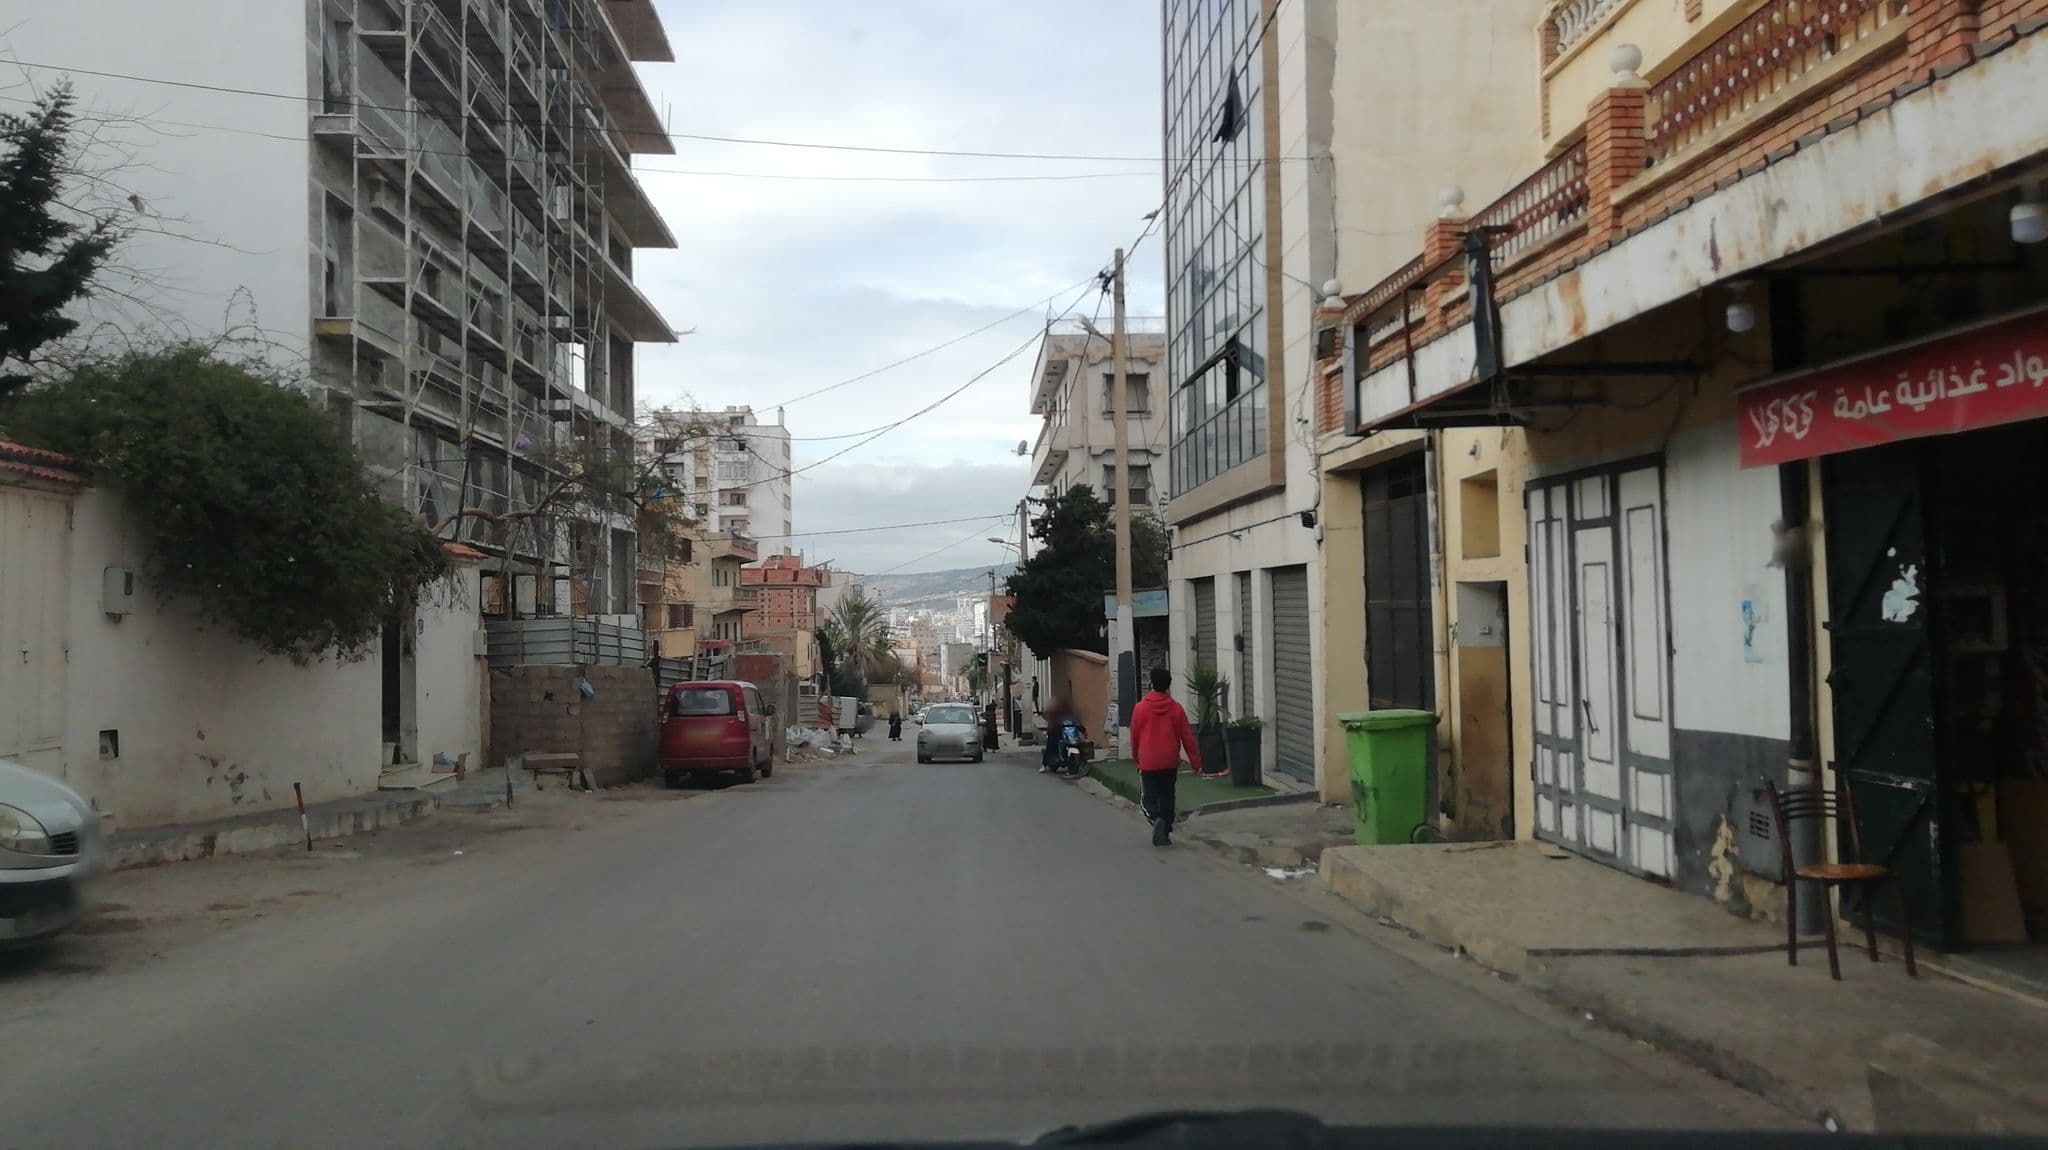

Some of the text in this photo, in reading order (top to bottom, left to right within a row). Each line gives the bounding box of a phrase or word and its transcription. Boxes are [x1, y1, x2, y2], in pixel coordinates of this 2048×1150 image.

[1895, 360, 1988, 412] غذائية
[1996, 350, 2048, 387] واد
[1833, 386, 1892, 419] عامة
